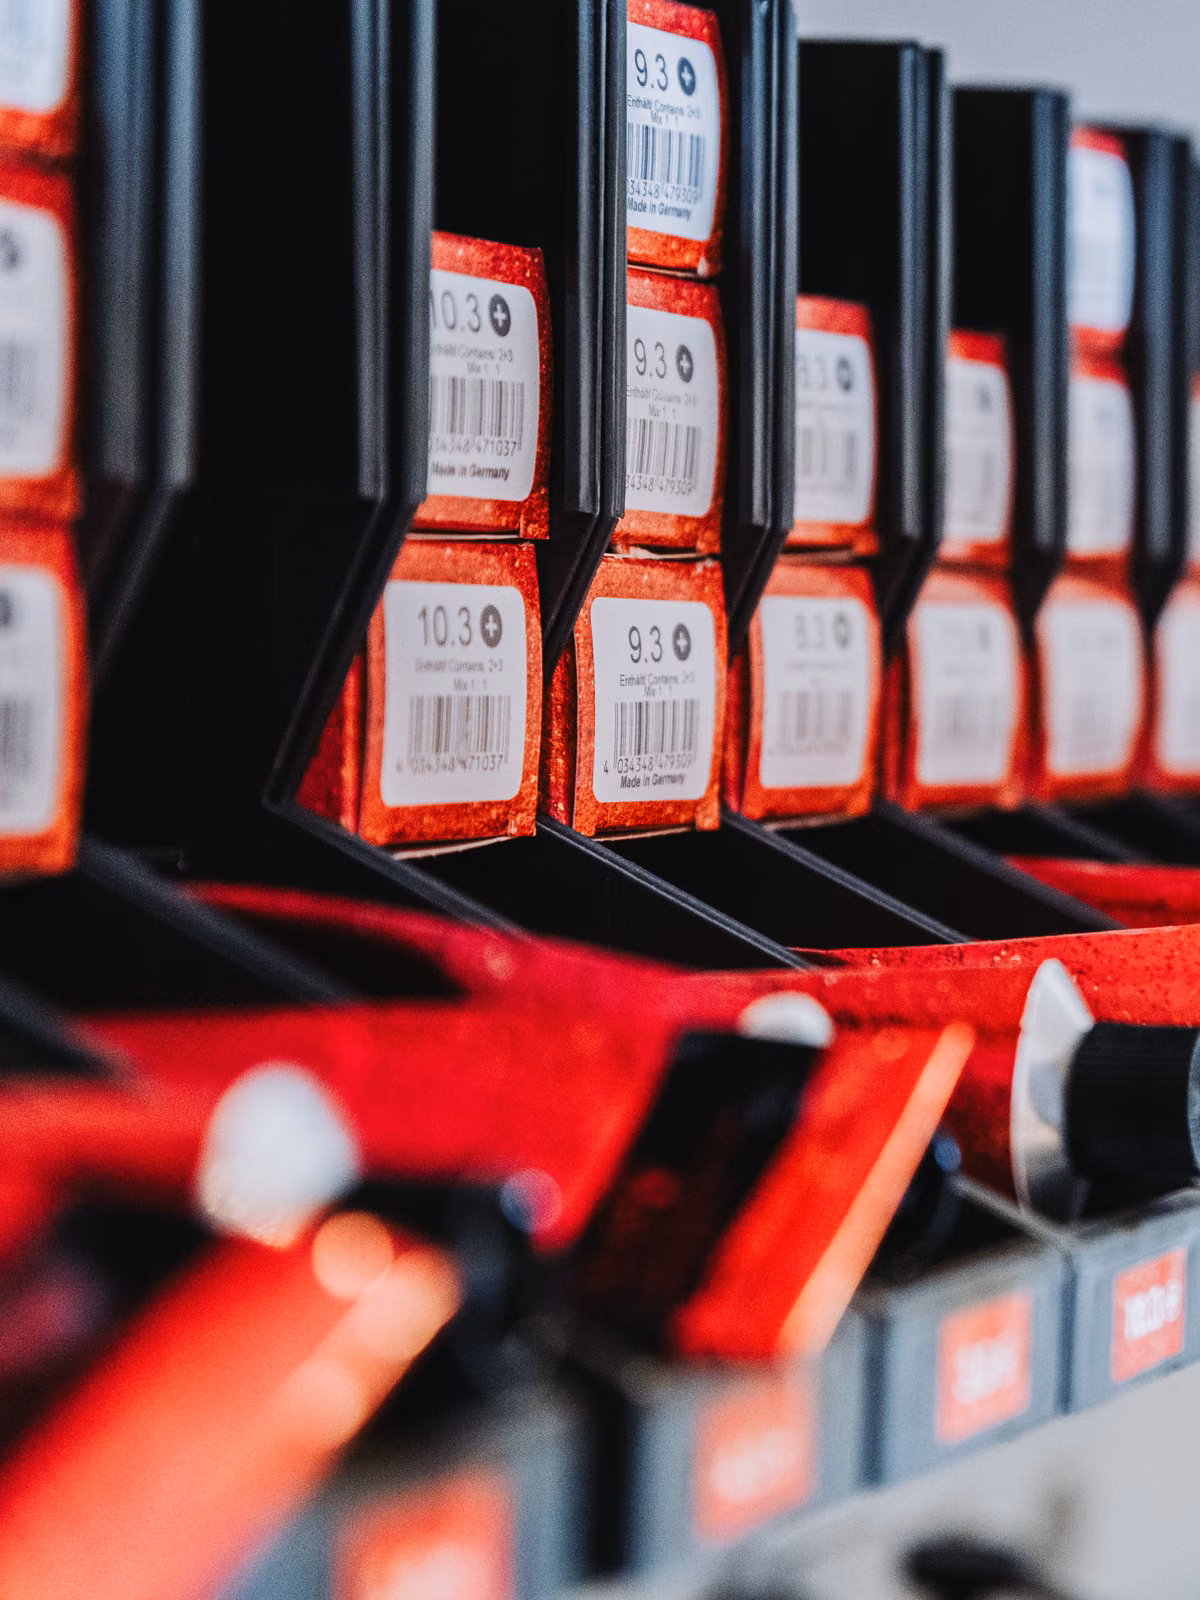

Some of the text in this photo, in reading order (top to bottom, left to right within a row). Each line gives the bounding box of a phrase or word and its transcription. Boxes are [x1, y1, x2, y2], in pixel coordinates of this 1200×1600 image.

[634, 48, 668, 92] 9.3
[627, 197, 691, 221] Made in Germany
[431, 288, 481, 333] 10.3
[633, 337, 667, 380] 9.3
[469, 462, 511, 482] Germany
[625, 473, 653, 492] 34348
[417, 604, 473, 648] 10.3
[628, 625, 663, 664] 9.3
[603, 761, 609, 775] 4
[617, 756, 653, 774] 034348
[620, 772, 685, 789] Made in Germany
